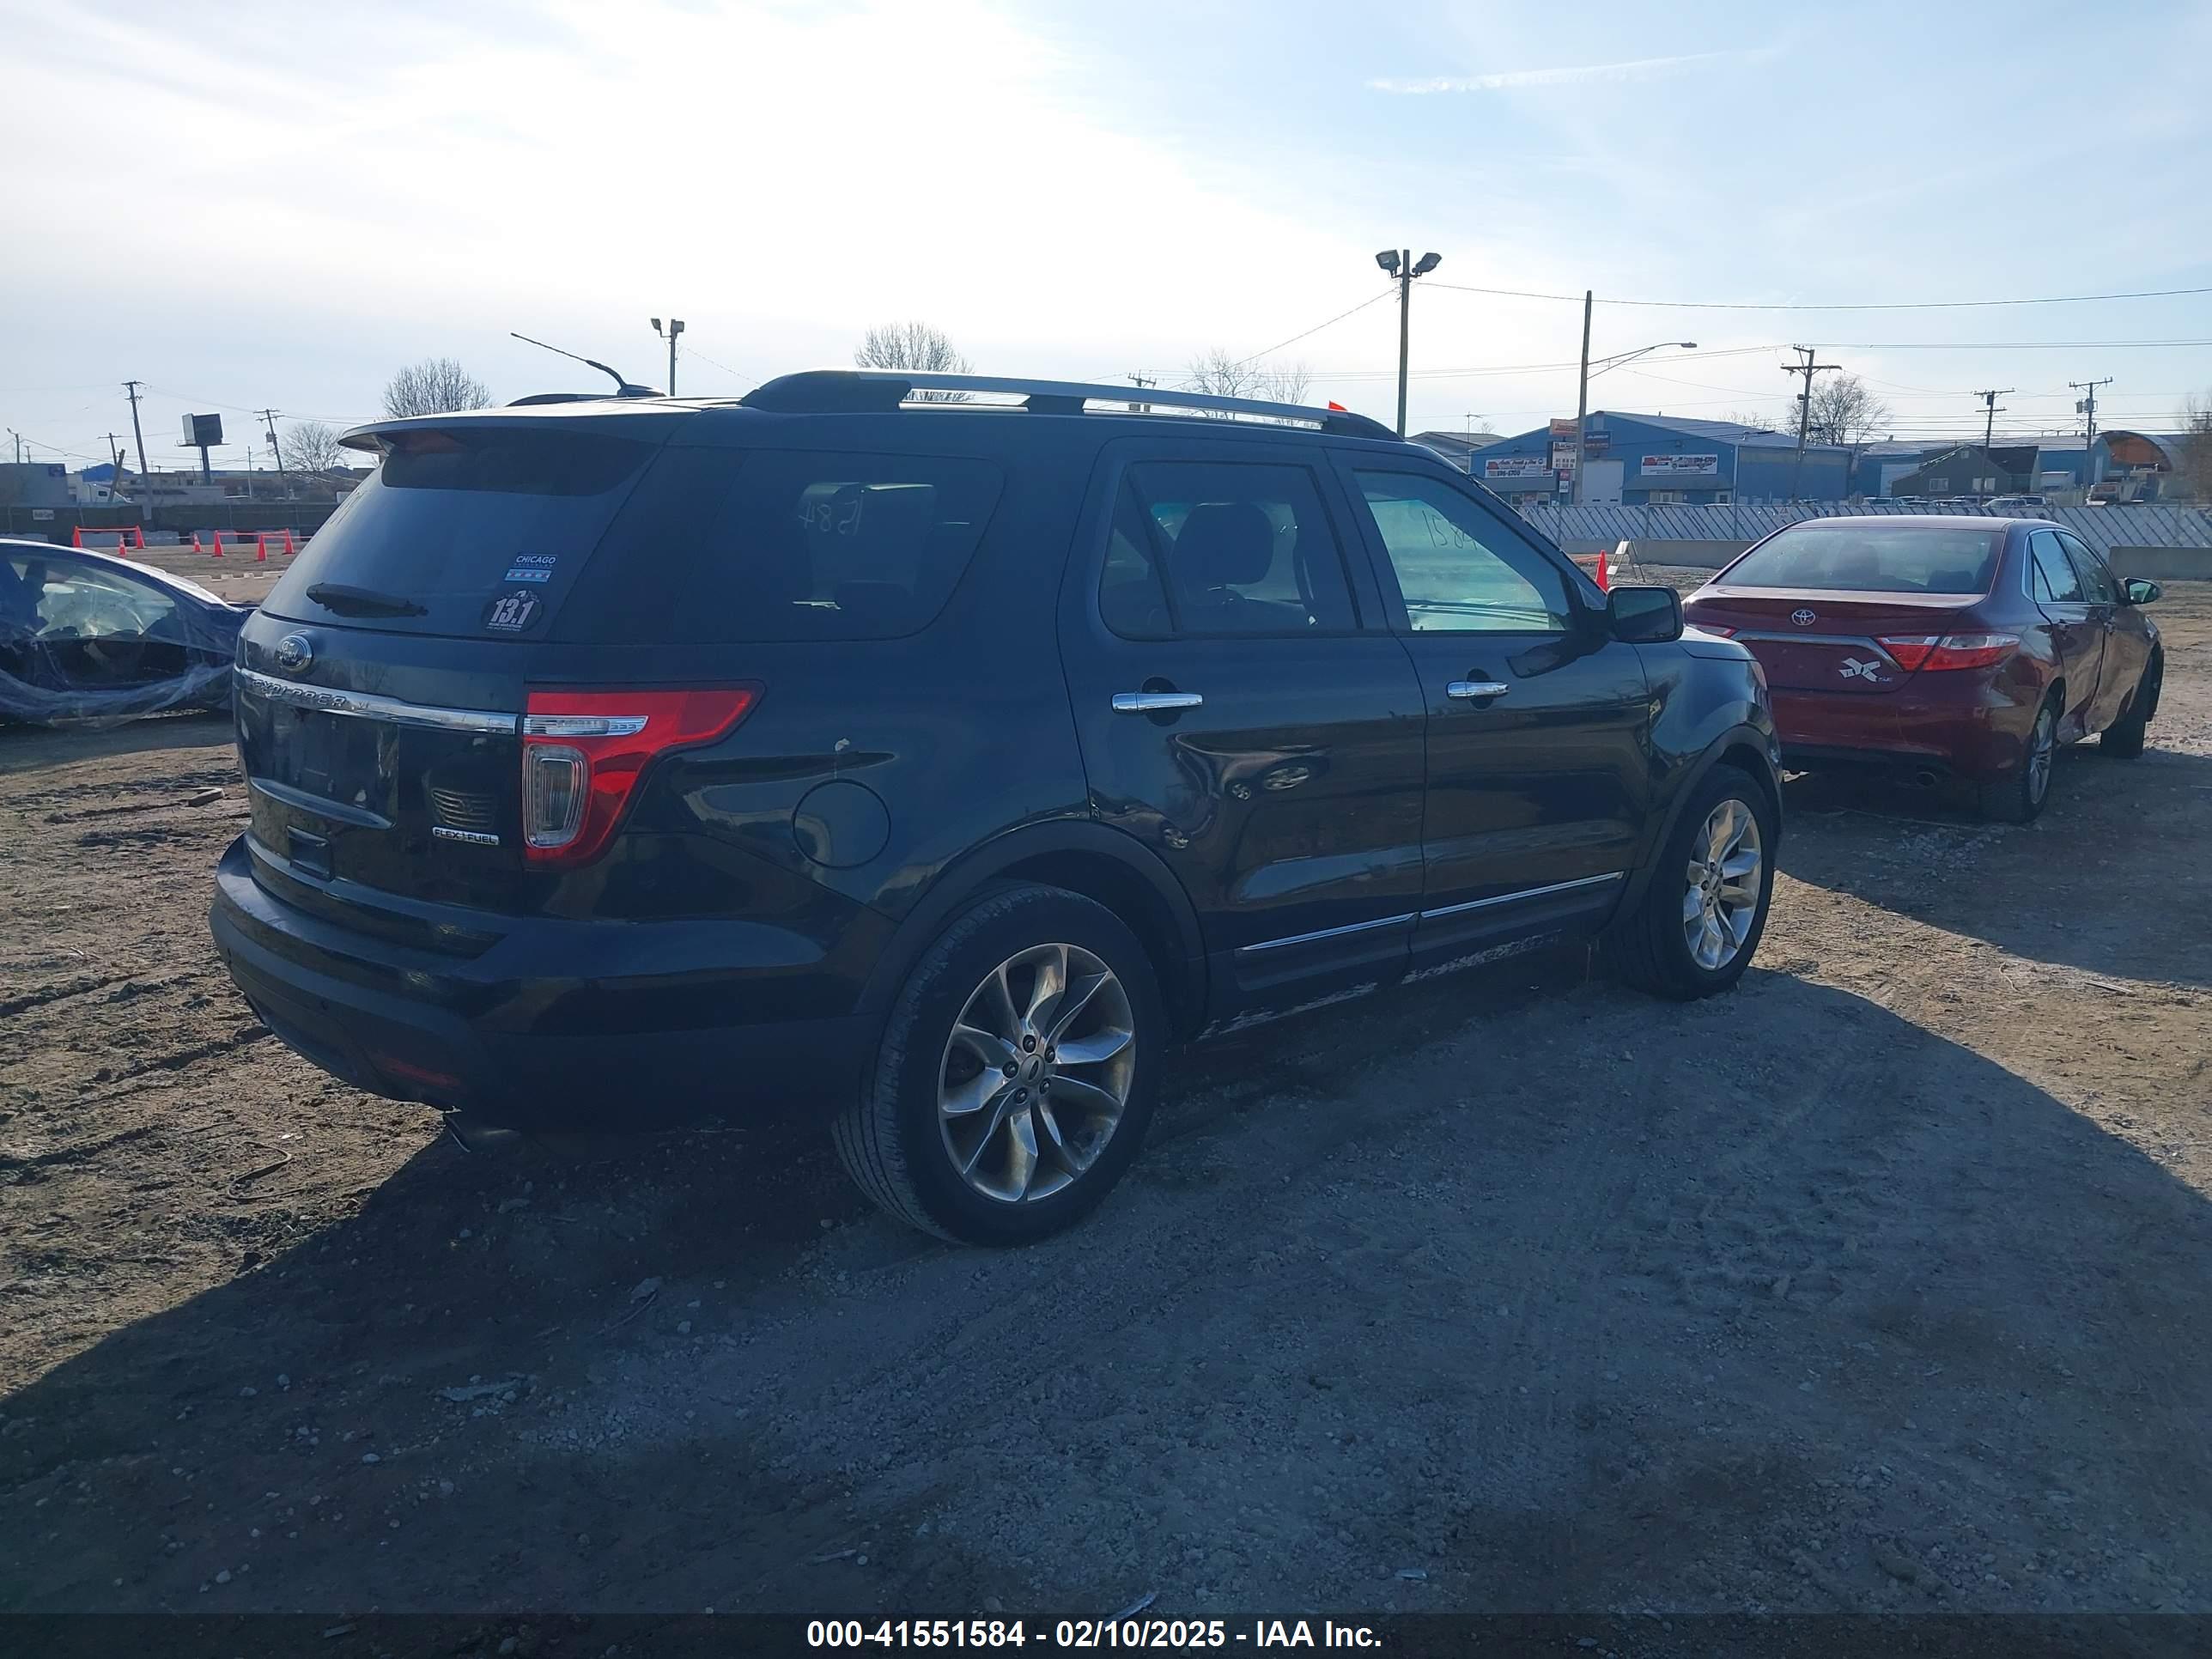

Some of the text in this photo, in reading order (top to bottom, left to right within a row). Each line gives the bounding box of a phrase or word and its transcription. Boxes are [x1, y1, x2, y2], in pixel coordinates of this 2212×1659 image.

[515, 556, 556, 564] CHICAGO
[490, 598, 535, 625] 13.1
[434, 829, 497, 845] FLEX FUEL
